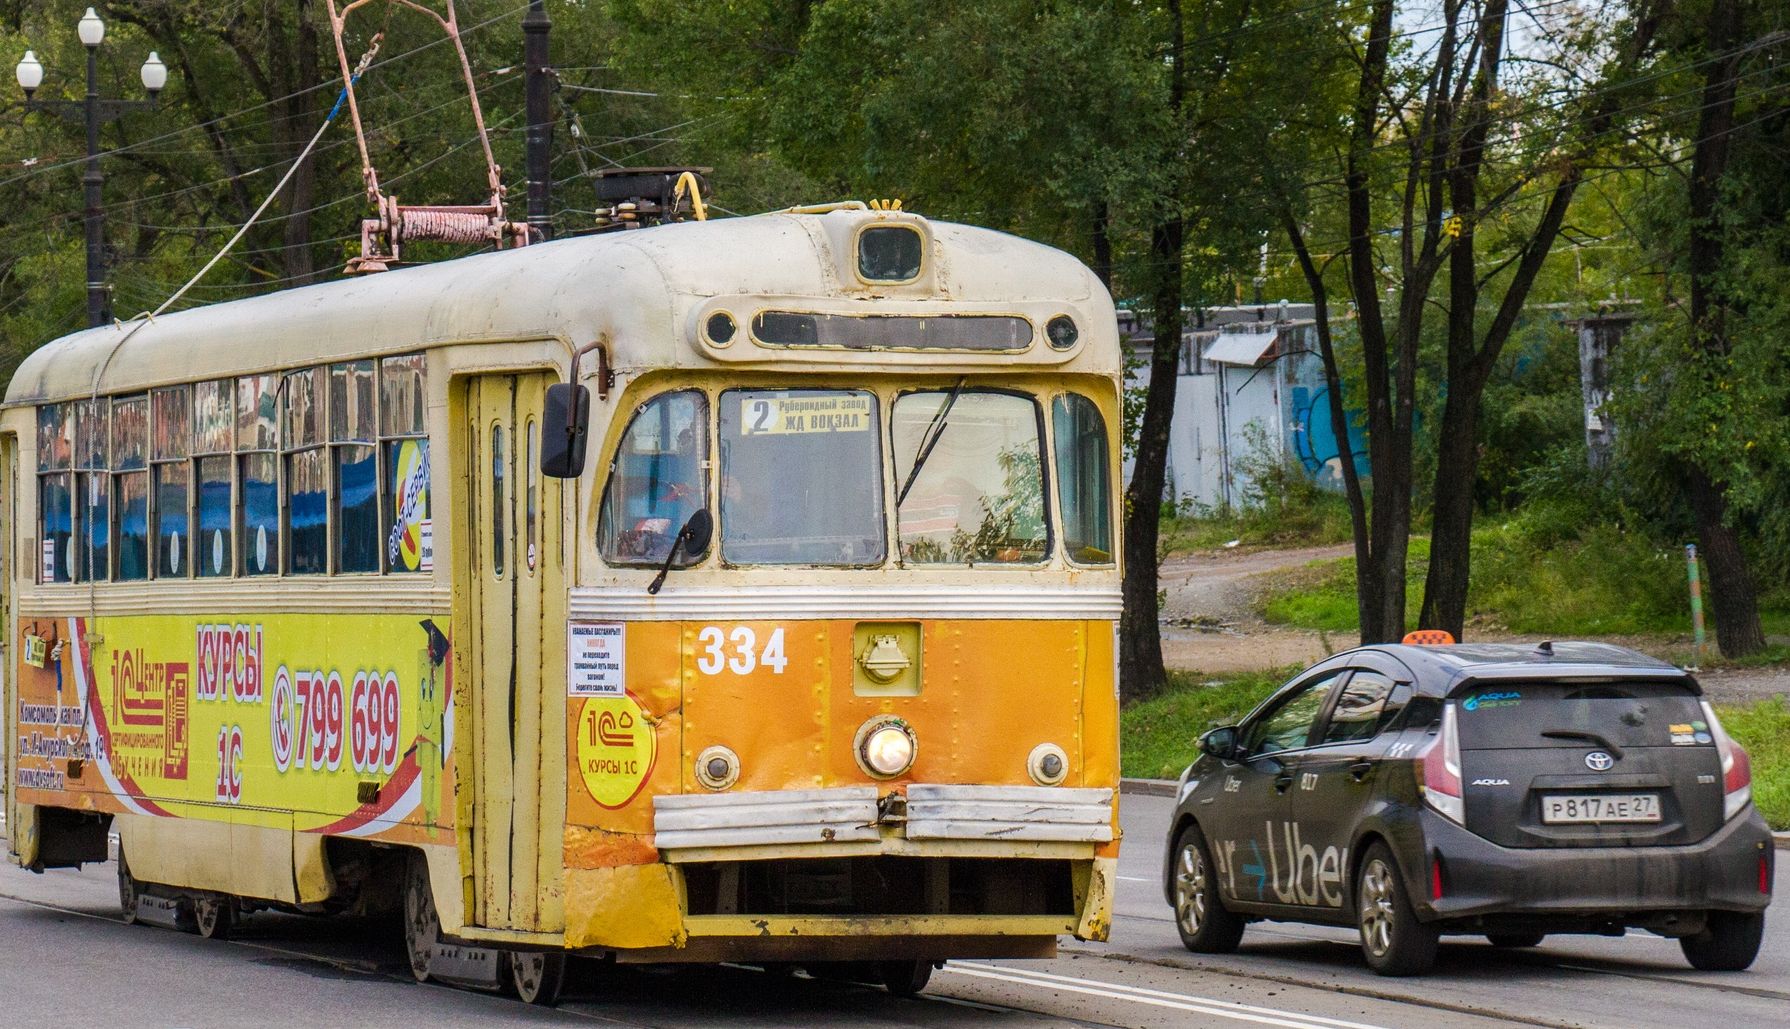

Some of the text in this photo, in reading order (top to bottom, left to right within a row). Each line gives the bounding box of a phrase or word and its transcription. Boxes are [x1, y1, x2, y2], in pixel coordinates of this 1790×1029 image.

[753, 401, 769, 432] 2
[779, 399, 866, 413] Рубероидный завод
[785, 413, 859, 431] ЖД ВОКЗАЛ
[197, 625, 262, 701] КУРСЫ
[697, 627, 788, 675] 334
[136, 648, 163, 700] ЦЕНТР
[295, 672, 399, 772] 799 699
[94, 735, 104, 760] 19
[217, 727, 242, 802] 1С
[588, 760, 637, 774] КУРСЫ 1С
[1224, 775, 1242, 792] Uber
[1301, 773, 1319, 790] 817
